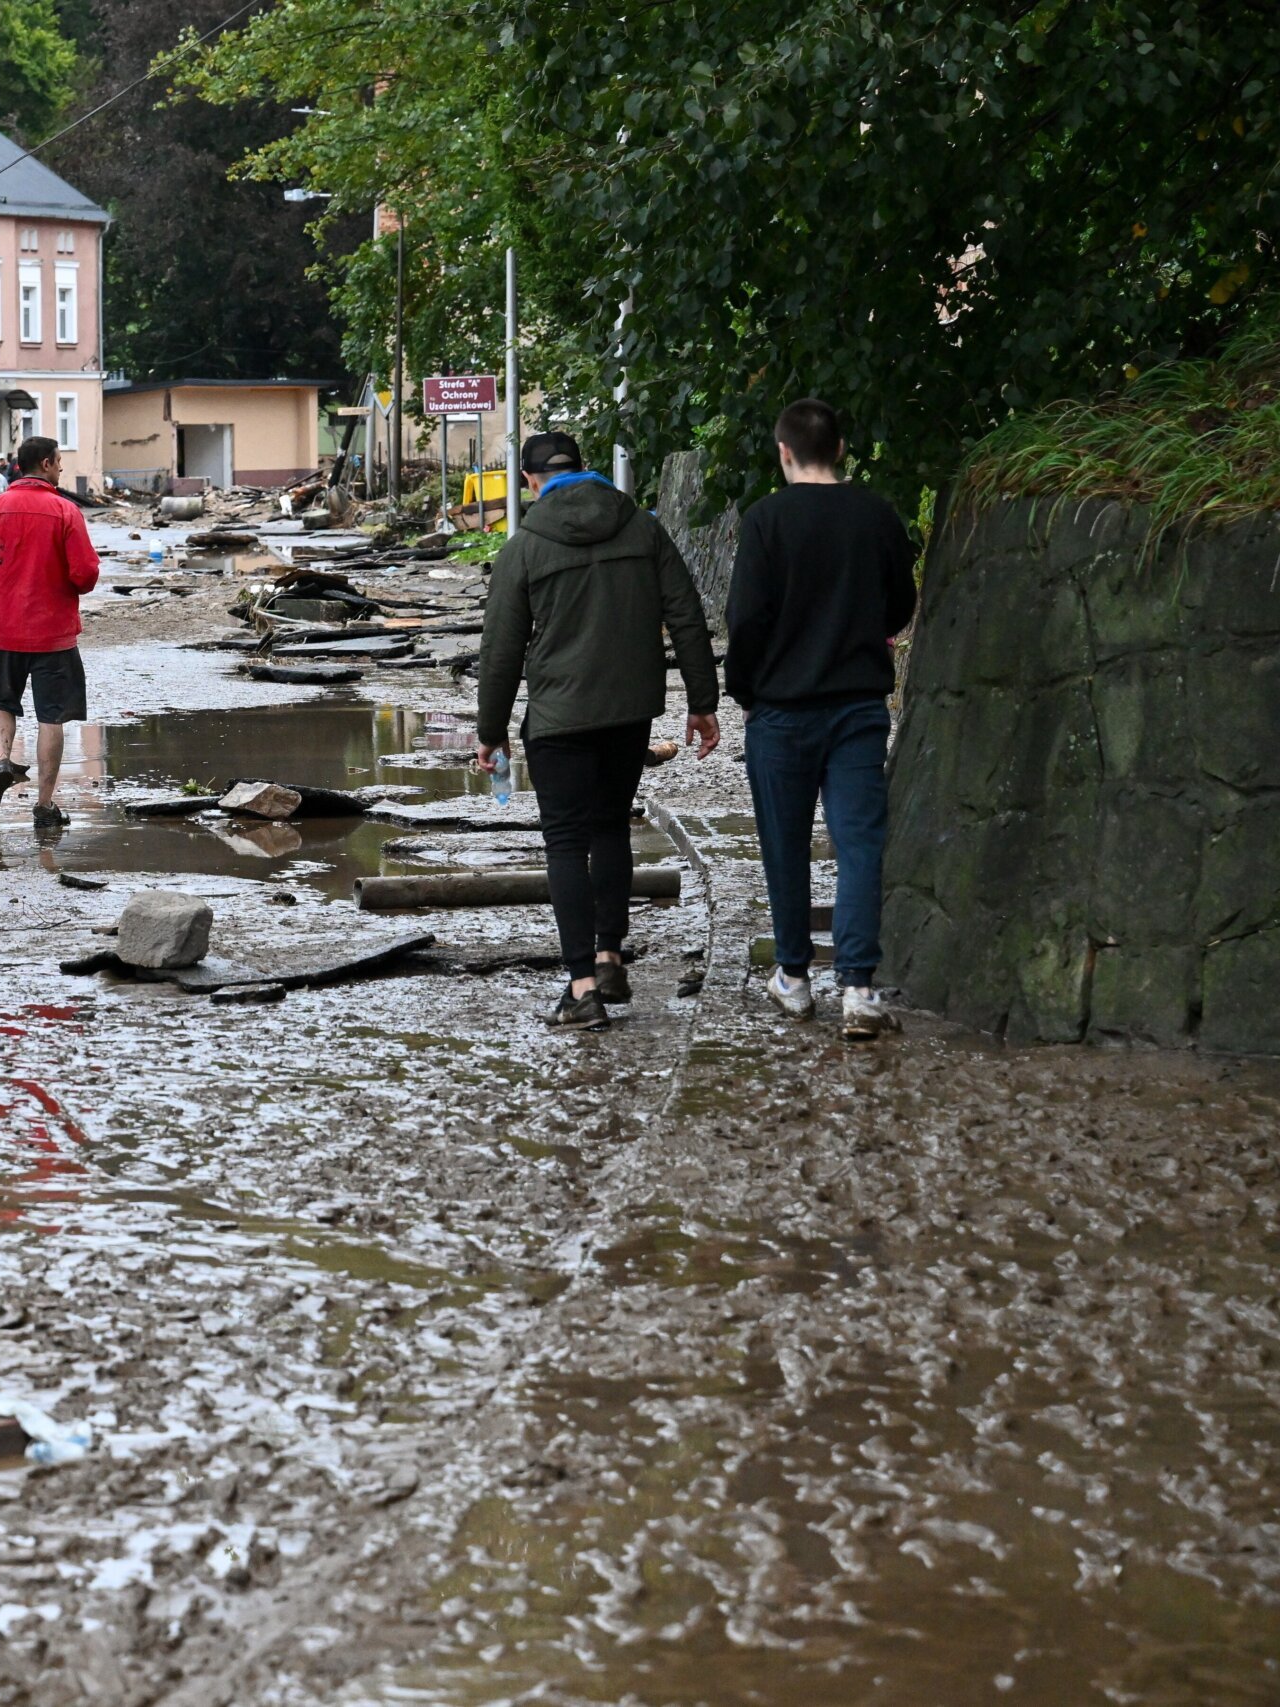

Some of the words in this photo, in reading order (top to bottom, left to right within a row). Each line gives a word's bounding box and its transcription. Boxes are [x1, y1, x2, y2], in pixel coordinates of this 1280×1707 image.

[438, 380, 465, 389] Strefa
[441, 391, 478, 400] Ochrony
[429, 400, 492, 411] Uzdrowiskowej
